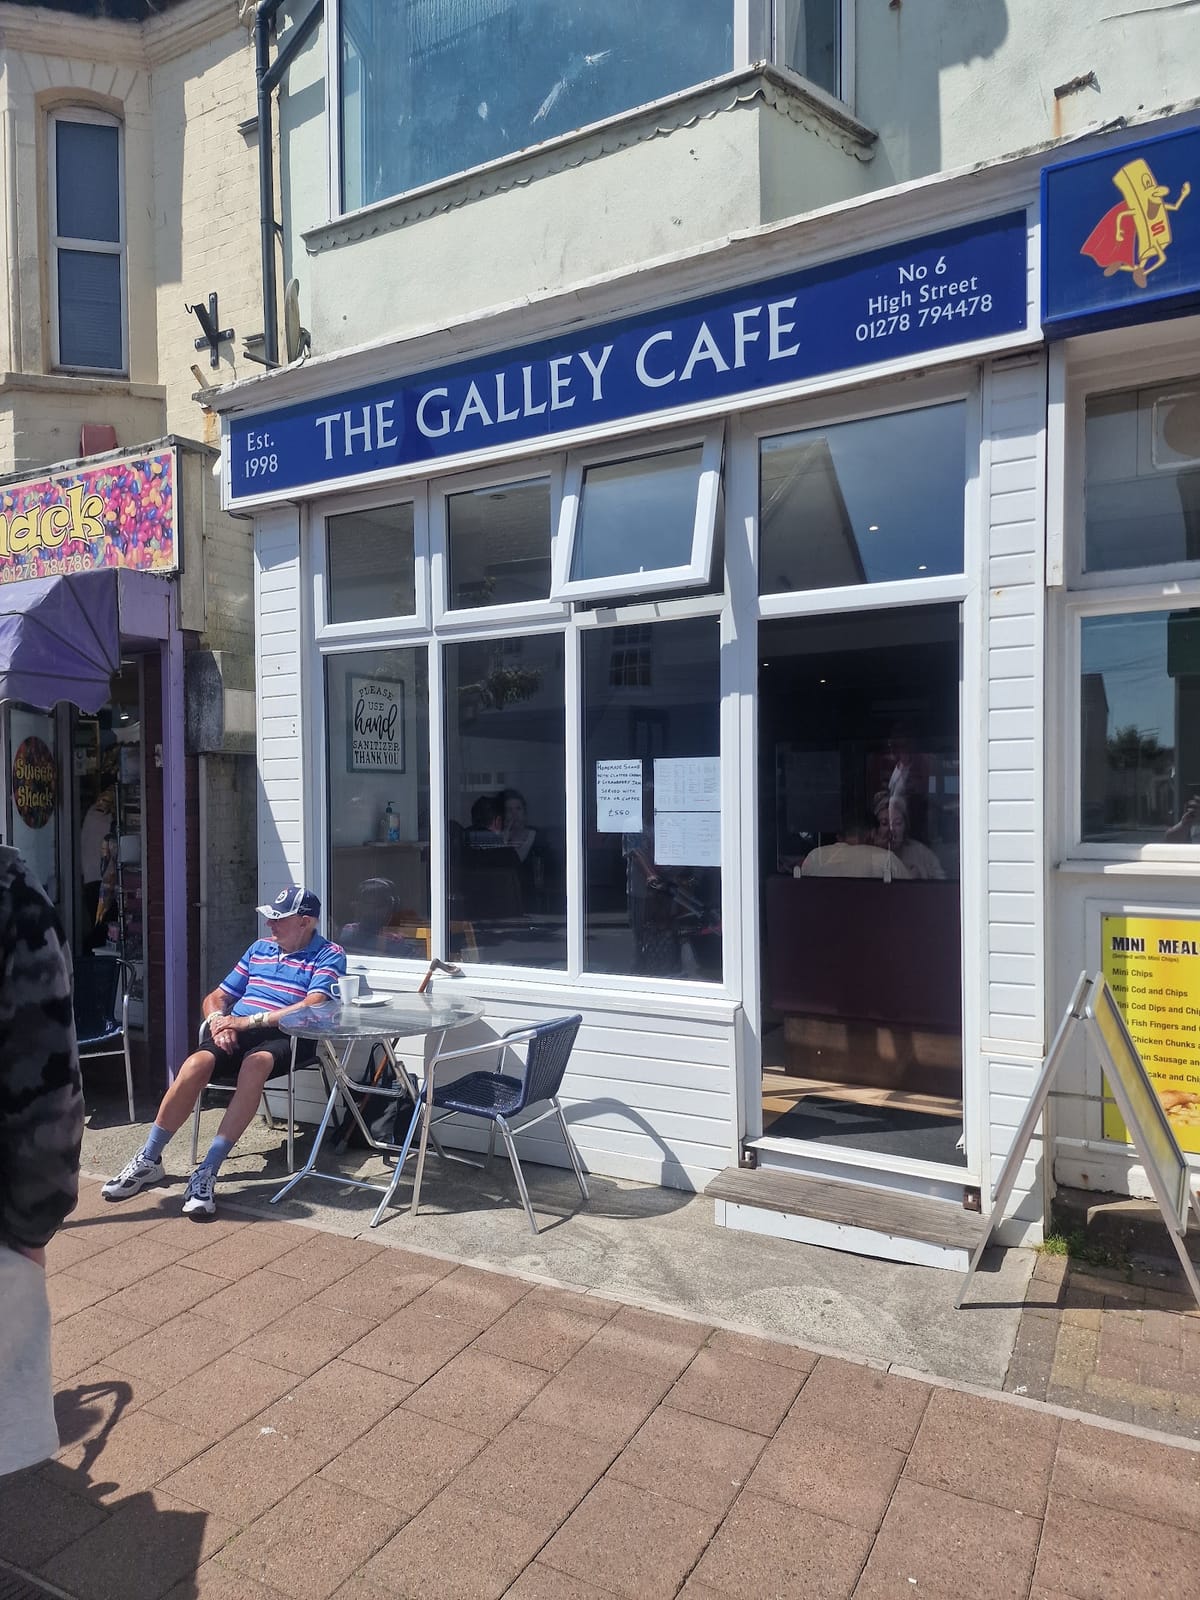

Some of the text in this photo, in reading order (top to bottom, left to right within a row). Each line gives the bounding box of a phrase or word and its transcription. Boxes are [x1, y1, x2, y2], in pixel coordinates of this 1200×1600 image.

[898, 256, 947, 284] No 6
[868, 275, 978, 316] High Street
[855, 294, 993, 342] 01278 794478
[316, 297, 800, 460] THE GALLEY CAFE
[247, 432, 275, 451] Est.
[244, 454, 278, 478] 1998
[3, 553, 91, 582] 01278 784786
[359, 685, 394, 701] PLEASE
[368, 701, 385, 711] USE
[354, 698, 398, 741] hand
[352, 741, 400, 752] SANITIZER
[354, 750, 399, 765] THANK YOU
[16, 759, 53, 780] Sweet
[17, 785, 53, 807] Shack
[1112, 936, 1200, 955] MINI MEAL
[1112, 968, 1153, 978] Mini Chips
[1112, 984, 1188, 998] Mini Cod and Chips
[1131, 1002, 1146, 1010] Cod
[1148, 1003, 1166, 1013] Dips
[1168, 1005, 1184, 1014] and
[1131, 1019, 1148, 1027] Fish
[1149, 1021, 1179, 1031] Fingers
[1181, 1023, 1197, 1032] and
[1165, 1038, 1196, 1049] Chunks
[1153, 1054, 1188, 1066] Sausage
[1168, 1072, 1184, 1081] and
[1186, 1074, 1200, 1083] Chi
